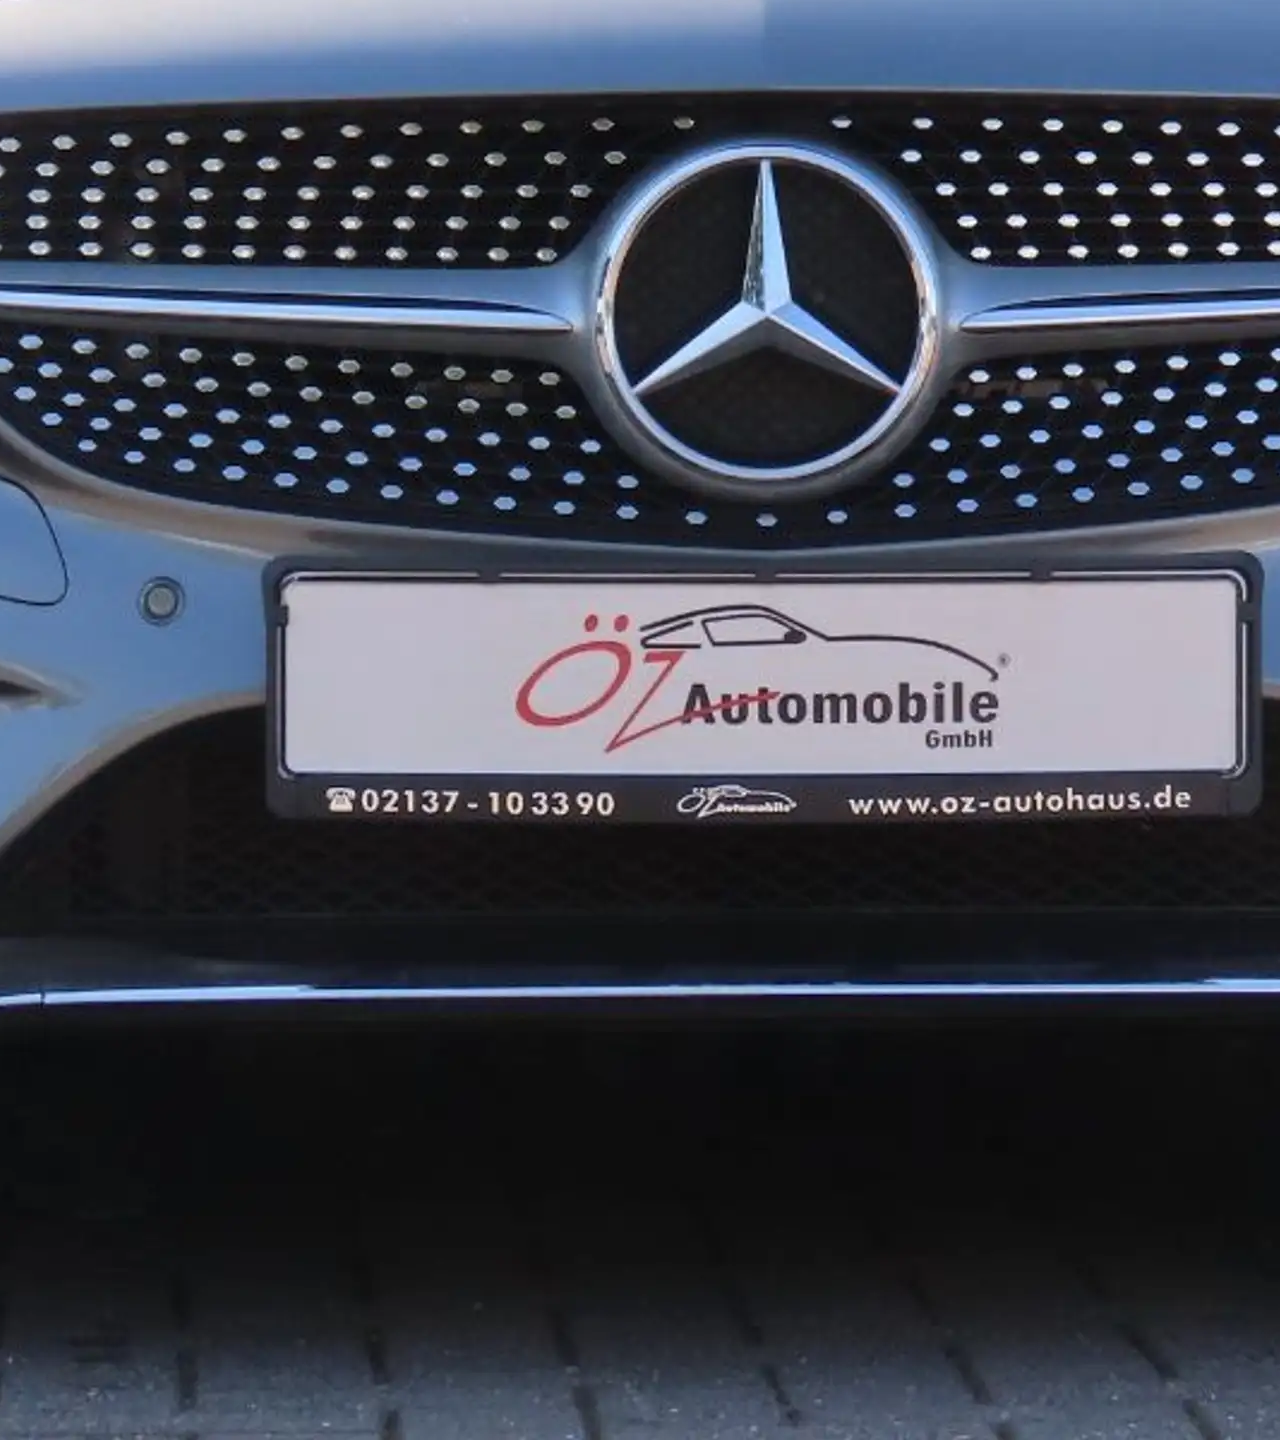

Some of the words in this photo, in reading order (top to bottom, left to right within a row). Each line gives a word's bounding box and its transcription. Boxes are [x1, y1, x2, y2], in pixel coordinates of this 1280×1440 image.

[515, 613, 781, 753] ÖZ
[682, 681, 999, 725] Automobile
[924, 728, 994, 749] GmbH
[848, 784, 1193, 816] www.oz-autohaus.de
